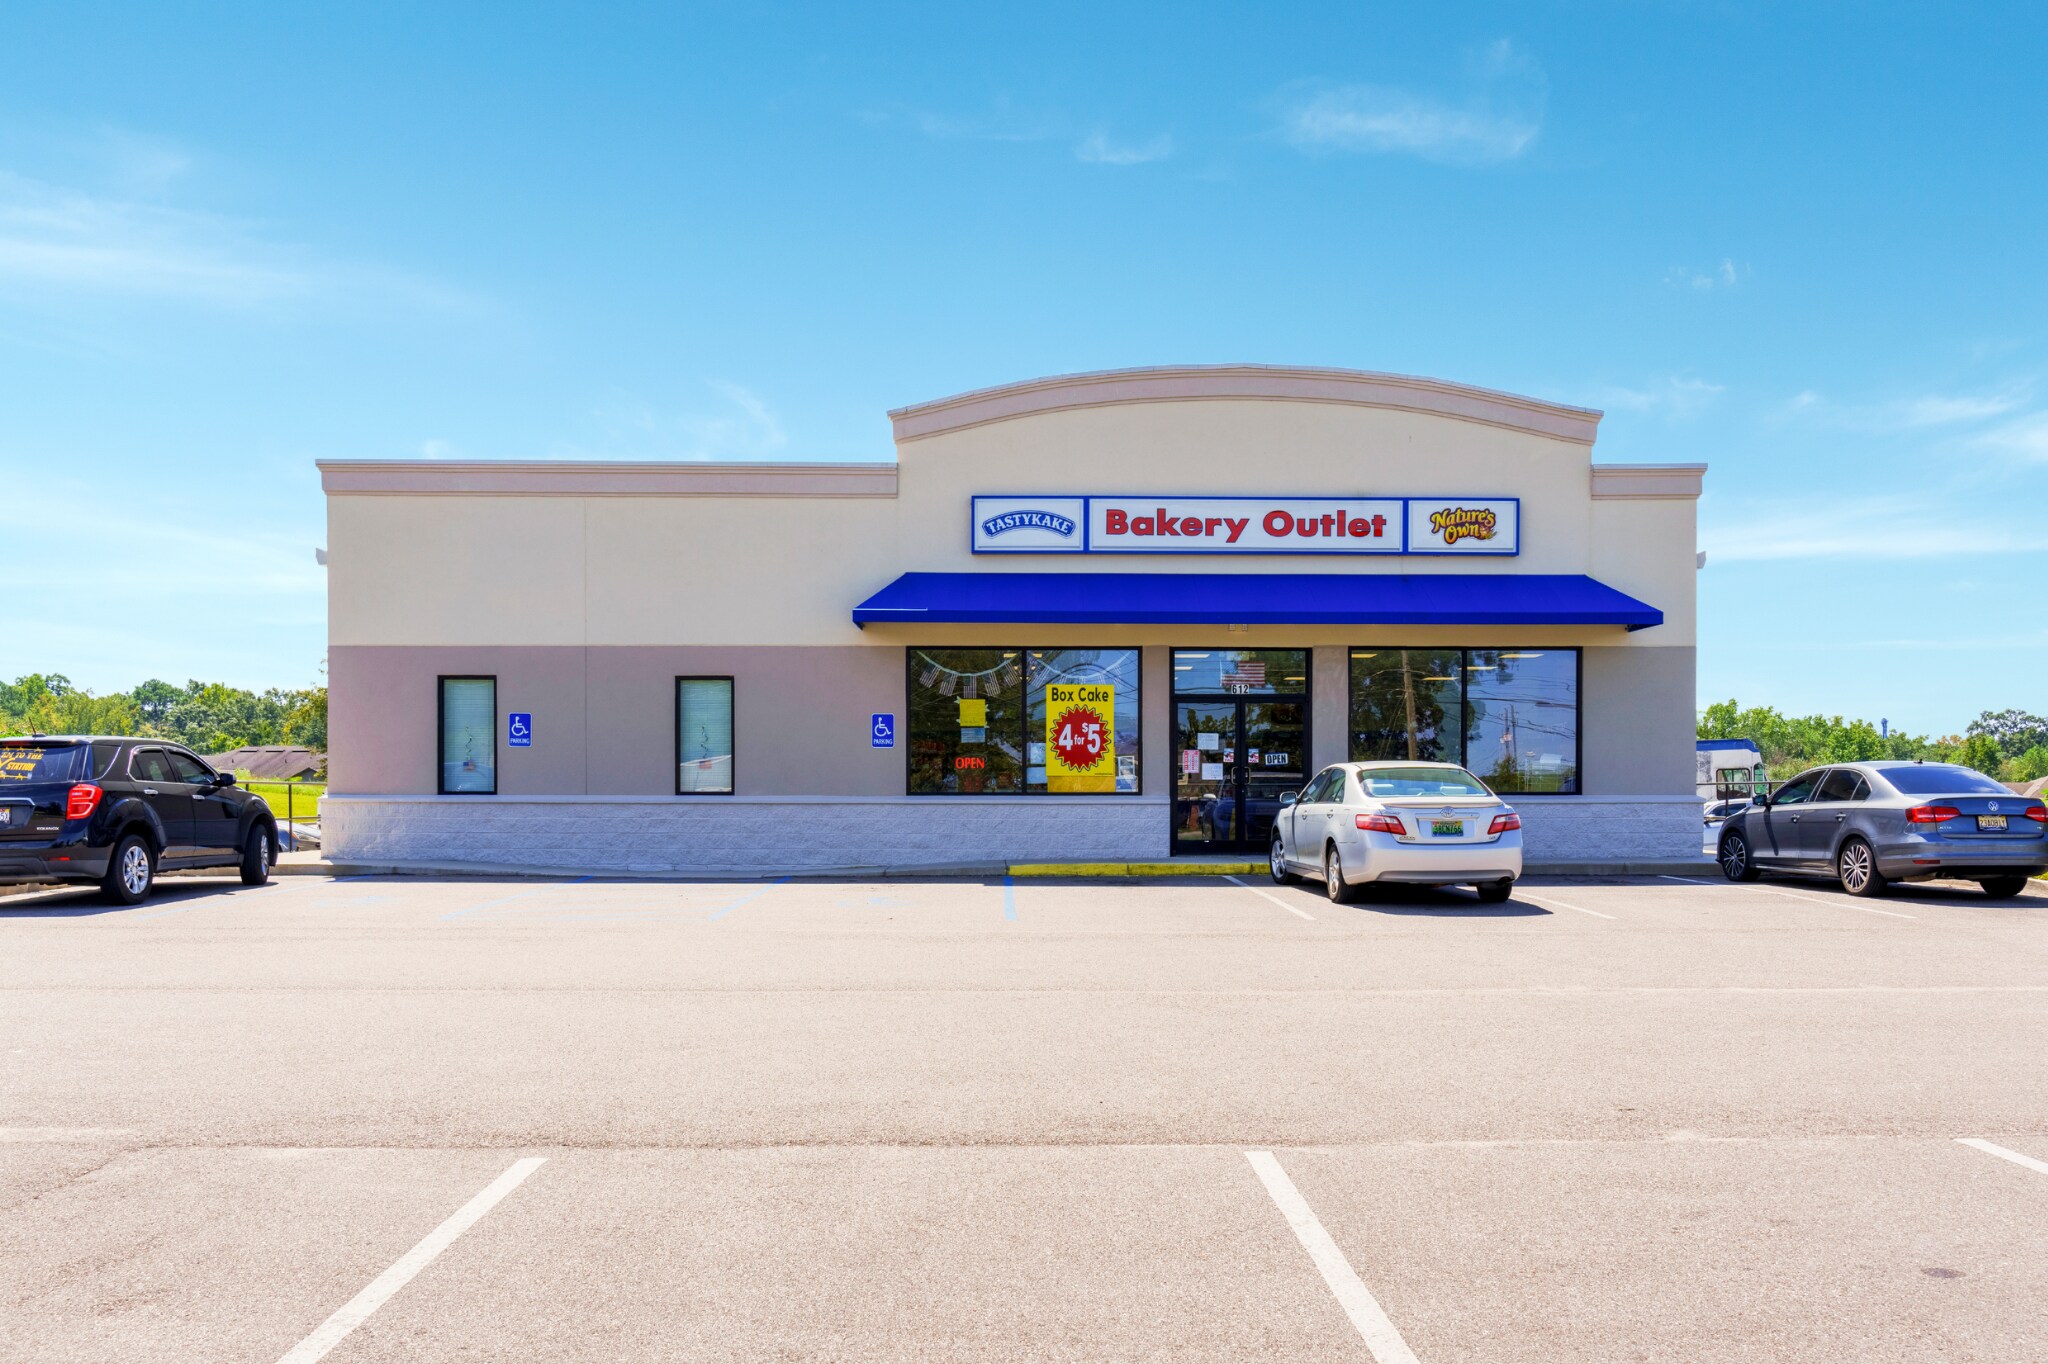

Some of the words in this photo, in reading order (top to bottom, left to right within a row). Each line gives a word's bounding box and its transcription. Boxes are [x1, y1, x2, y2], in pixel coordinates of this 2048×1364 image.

[986, 513, 1071, 534] TASTYKAKE
[1106, 508, 1250, 543] Bakery
[1263, 510, 1387, 537] Outlet
[1430, 507, 1496, 534] Nature's
[1444, 523, 1480, 545] Own
[1051, 687, 1074, 702] Box
[1078, 687, 1109, 702] Cake
[1232, 684, 1249, 694] 612
[1058, 723, 1073, 751] 4
[1074, 734, 1085, 745] for
[955, 757, 985, 769] OPEN
[1266, 754, 1287, 764] OPEN
